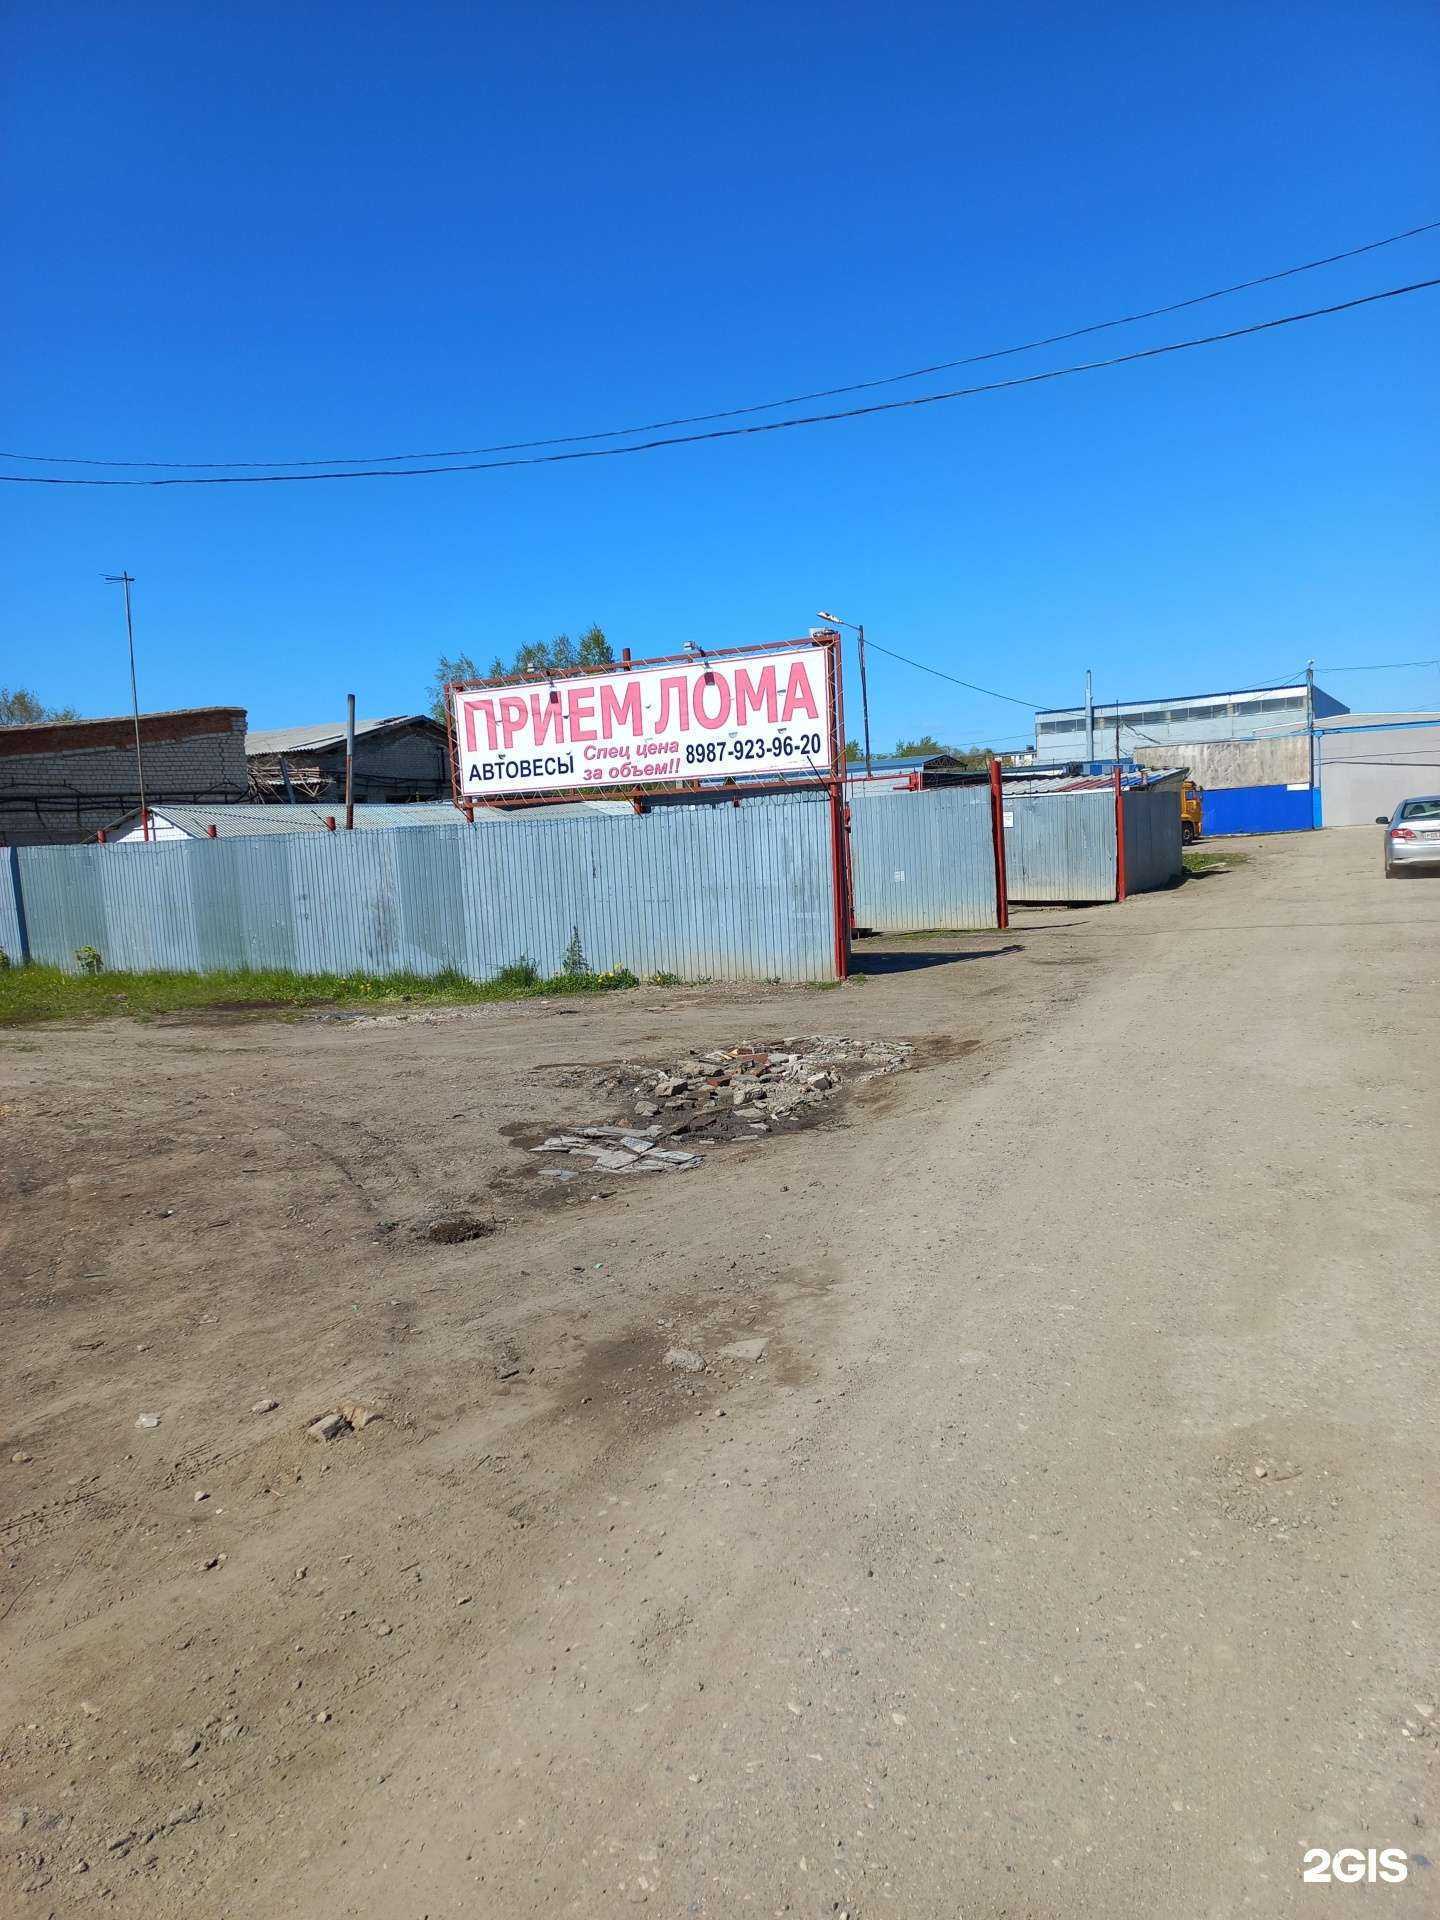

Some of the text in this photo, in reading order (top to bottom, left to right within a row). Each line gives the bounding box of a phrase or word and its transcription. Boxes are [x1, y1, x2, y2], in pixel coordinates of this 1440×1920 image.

[463, 661, 819, 752] ПРИЕМ ЛОМА
[583, 739, 679, 761] Спец цена
[686, 733, 821, 764] 8987-923-96-20
[469, 755, 574, 781] АВТОВЕСЫ
[583, 758, 680, 780] за объем!!
